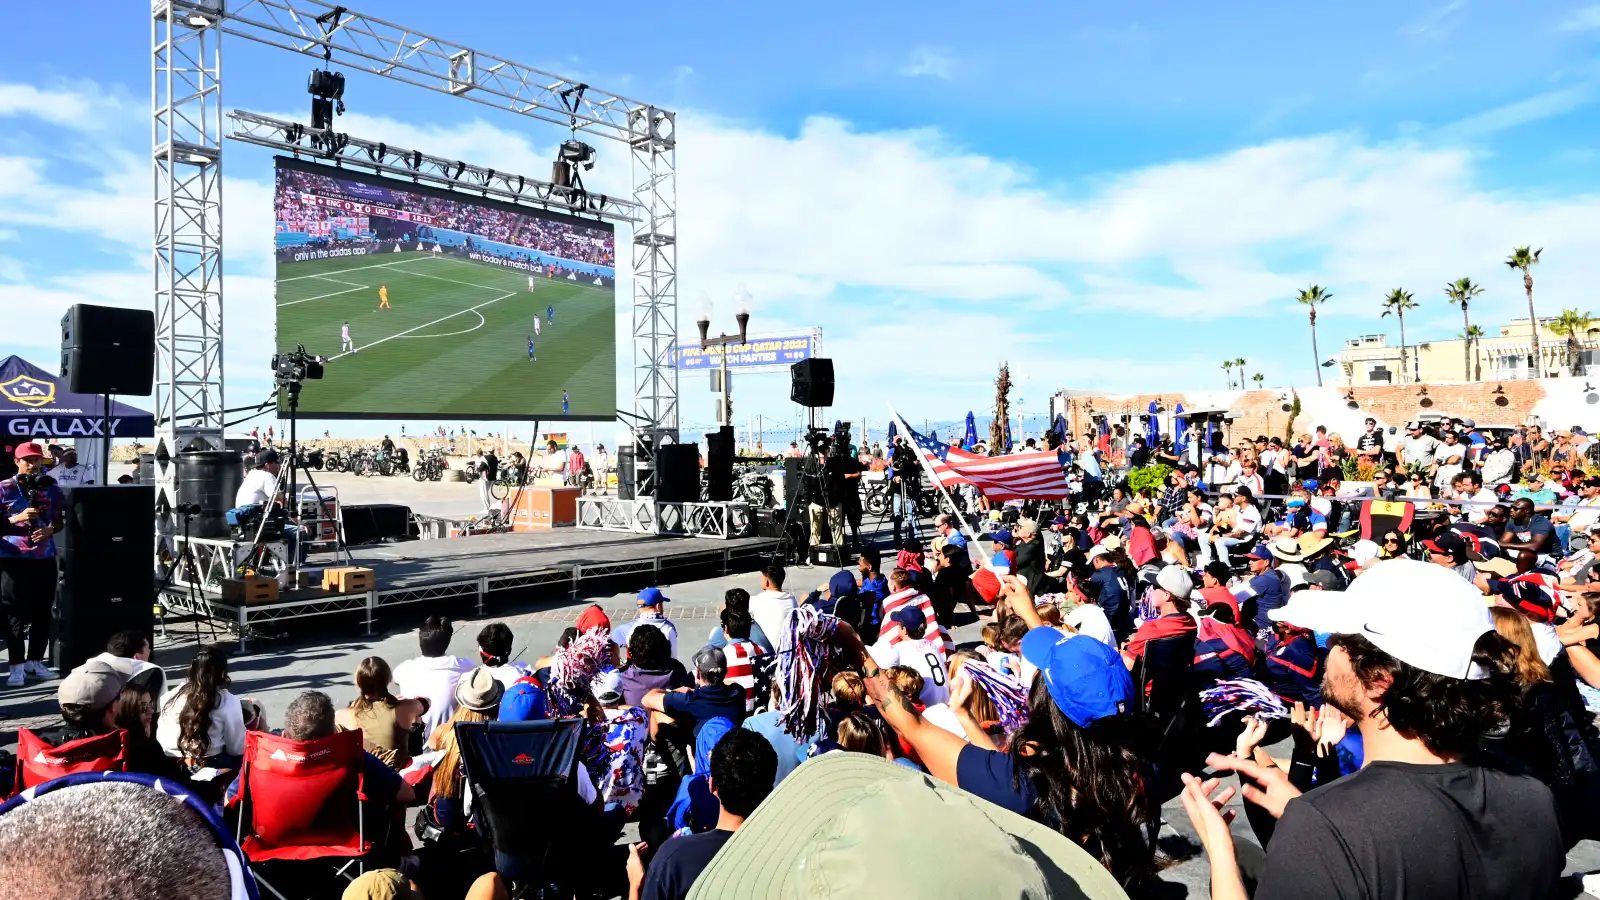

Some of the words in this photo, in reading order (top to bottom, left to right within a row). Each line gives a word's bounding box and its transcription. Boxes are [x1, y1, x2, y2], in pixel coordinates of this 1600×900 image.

[326, 199, 341, 208] ENG
[344, 202, 351, 210] 0
[375, 208, 389, 216] USA
[412, 214, 432, 224] 18:12
[294, 251, 309, 262] only
[310, 250, 317, 260] in
[317, 248, 328, 258] the
[329, 246, 352, 258] adidas
[352, 246, 366, 255] app
[469, 252, 481, 260] win
[482, 254, 507, 266] today's
[508, 260, 530, 270] match
[530, 264, 543, 273] ball
[682, 347, 700, 357] FIFA
[701, 345, 732, 356] WORD
[734, 344, 751, 353] CUP
[753, 342, 782, 352] QATAR
[784, 340, 807, 350] 2022
[710, 354, 739, 364] WACH
[741, 352, 776, 363] PARTIES
[13, 387, 46, 396] LA
[8, 418, 121, 435] GALAXY
[924, 652, 946, 687] 8
